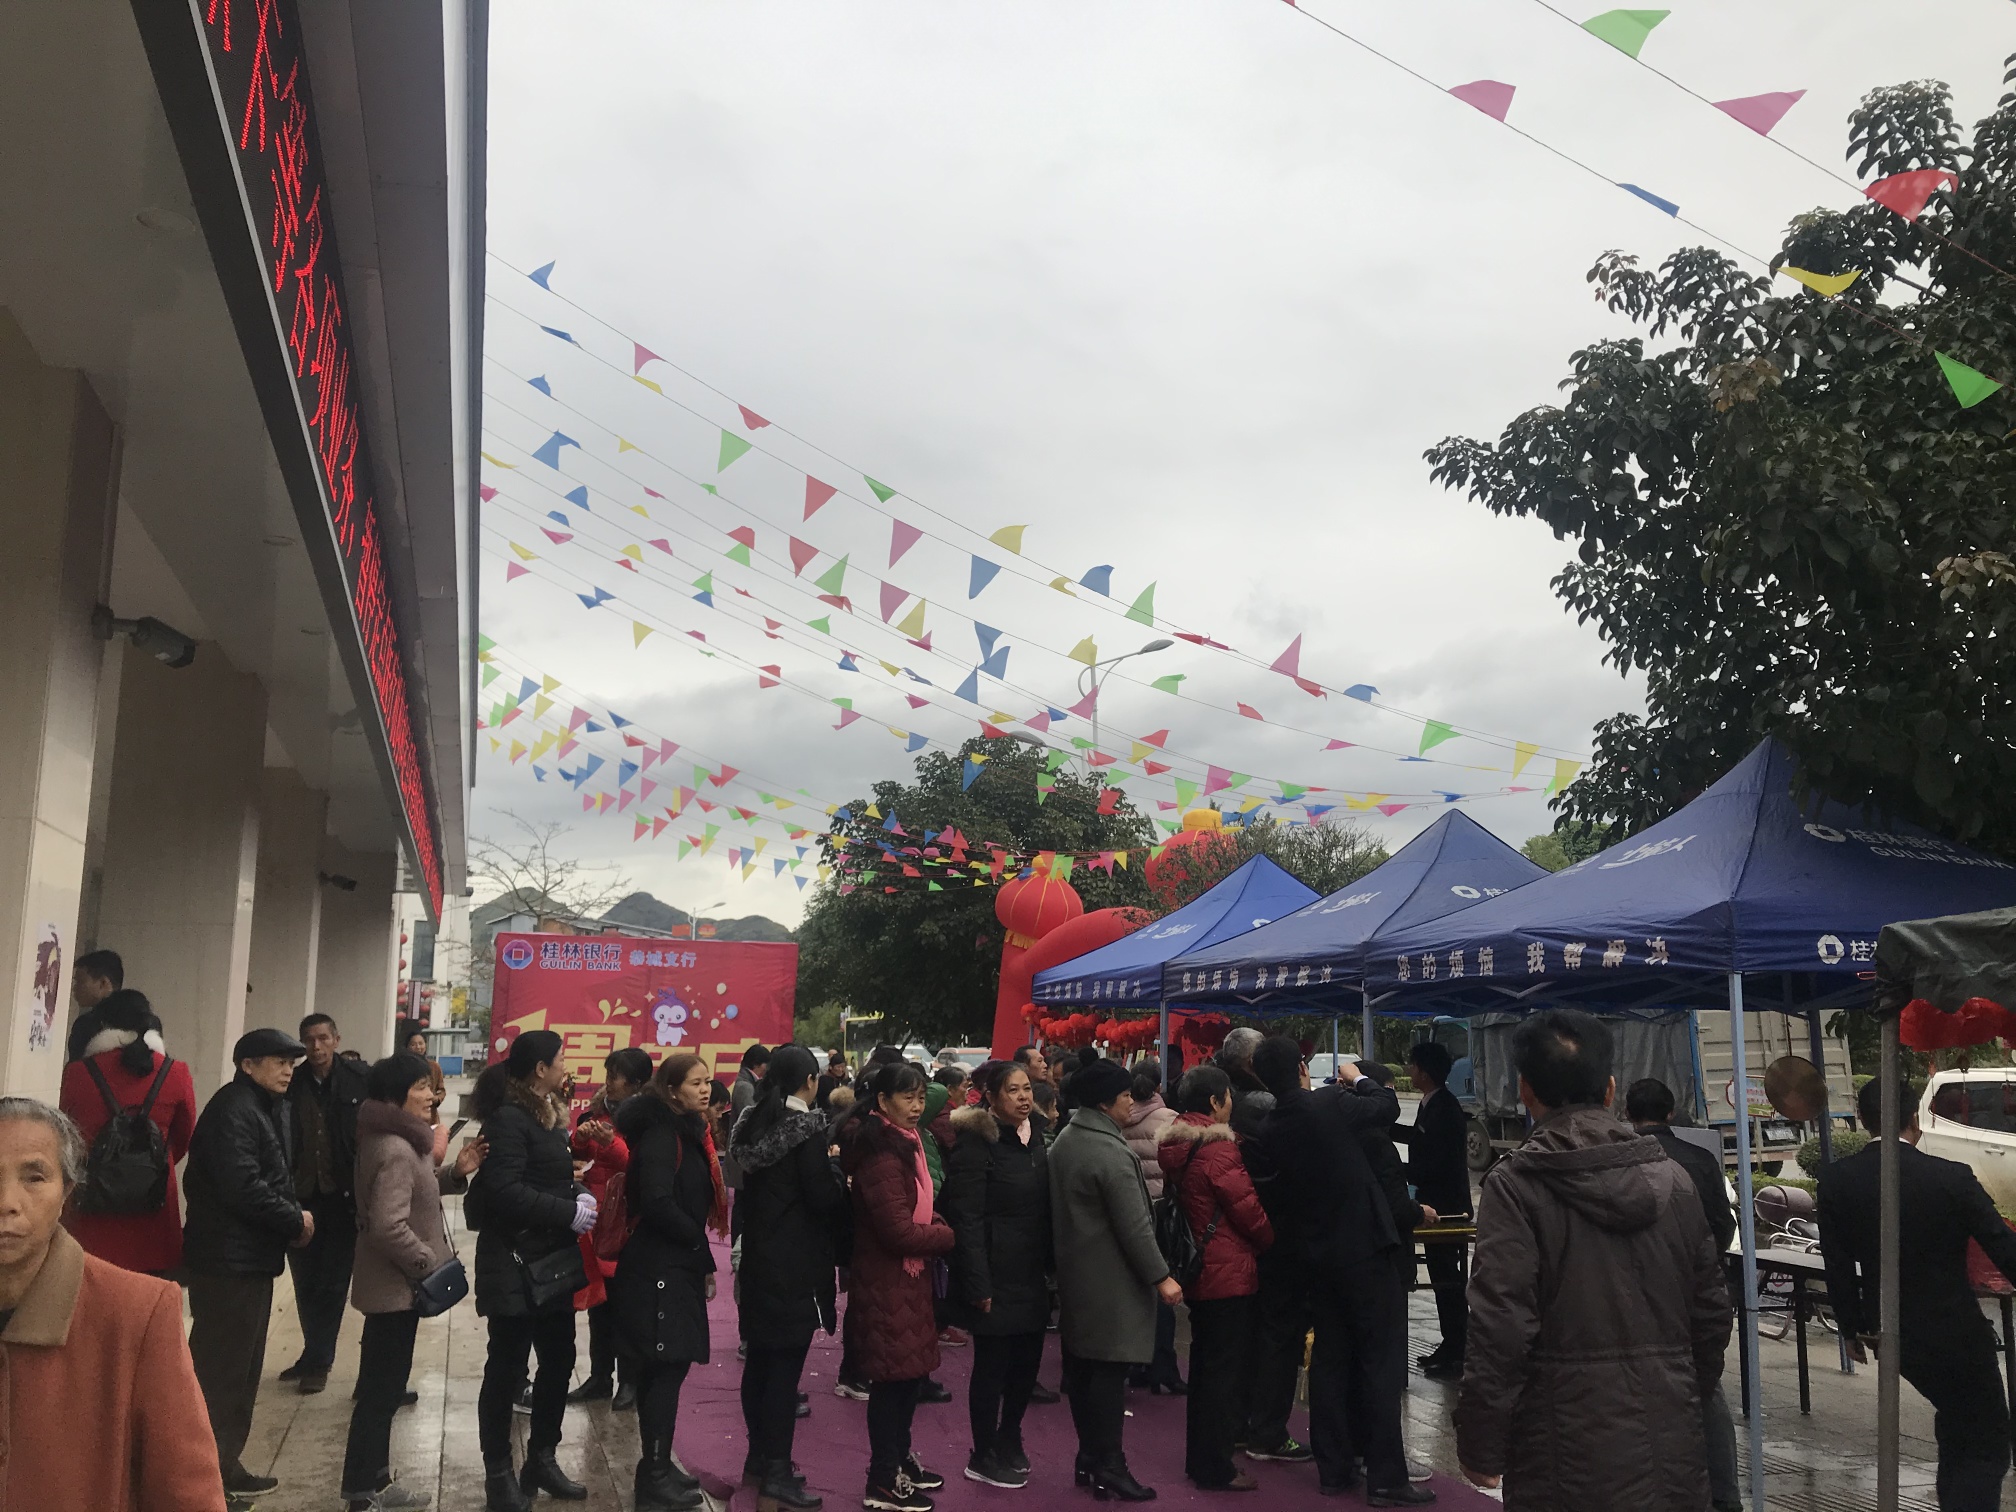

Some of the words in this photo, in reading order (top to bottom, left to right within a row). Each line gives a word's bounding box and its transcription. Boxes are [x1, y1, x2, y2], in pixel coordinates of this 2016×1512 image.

[1846, 828, 1956, 853] 桂林银行
[1869, 846, 1948, 863] GUILIN
[1949, 854, 2014, 870] BANK
[540, 941, 622, 961] 桂林银行
[628, 949, 697, 969] 恭城支行
[1397, 946, 1494, 982] 您的烦恼
[1526, 936, 1671, 974] 我帮解决
[539, 960, 582, 971] GUILIN
[586, 961, 622, 972] BANK
